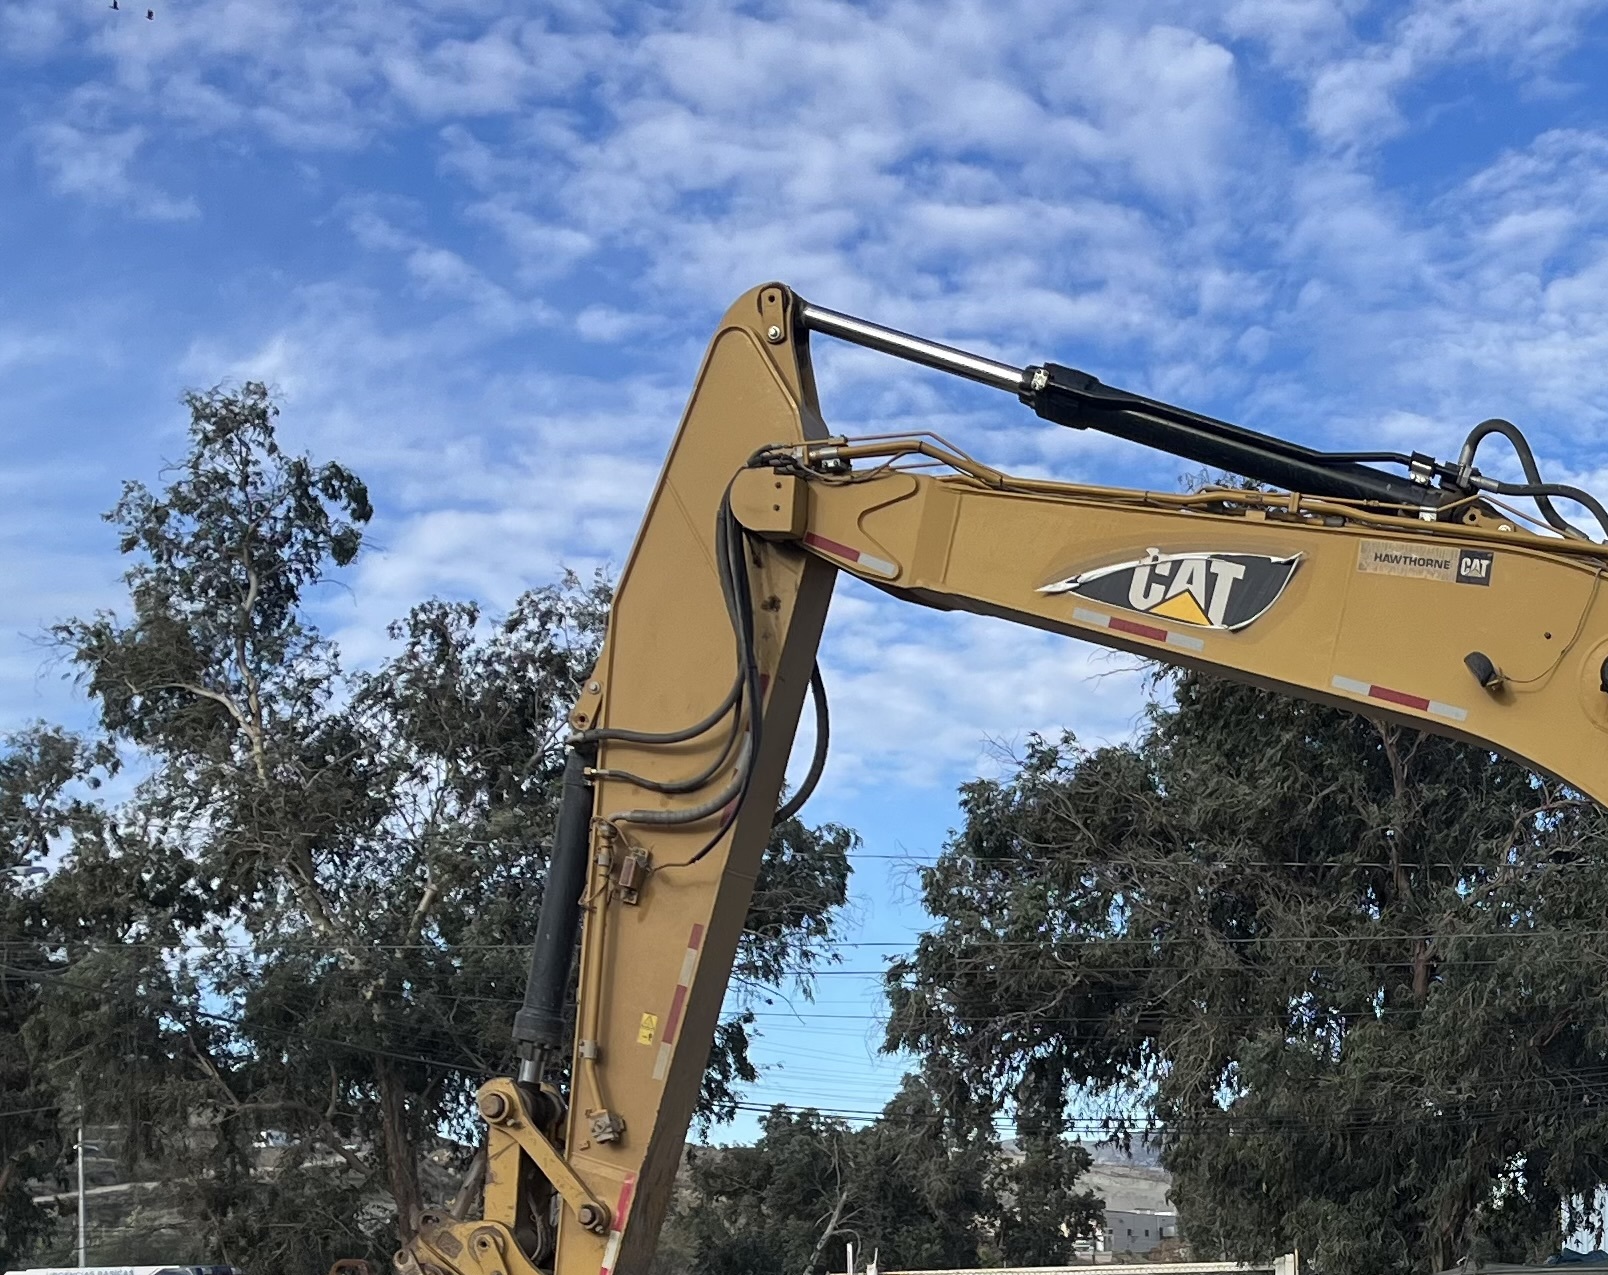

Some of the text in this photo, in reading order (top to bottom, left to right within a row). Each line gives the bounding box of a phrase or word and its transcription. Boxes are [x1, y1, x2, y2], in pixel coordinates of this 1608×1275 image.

[1128, 550, 1246, 626] CAT
[1373, 552, 1492, 578] HAWTHORNE CAT
